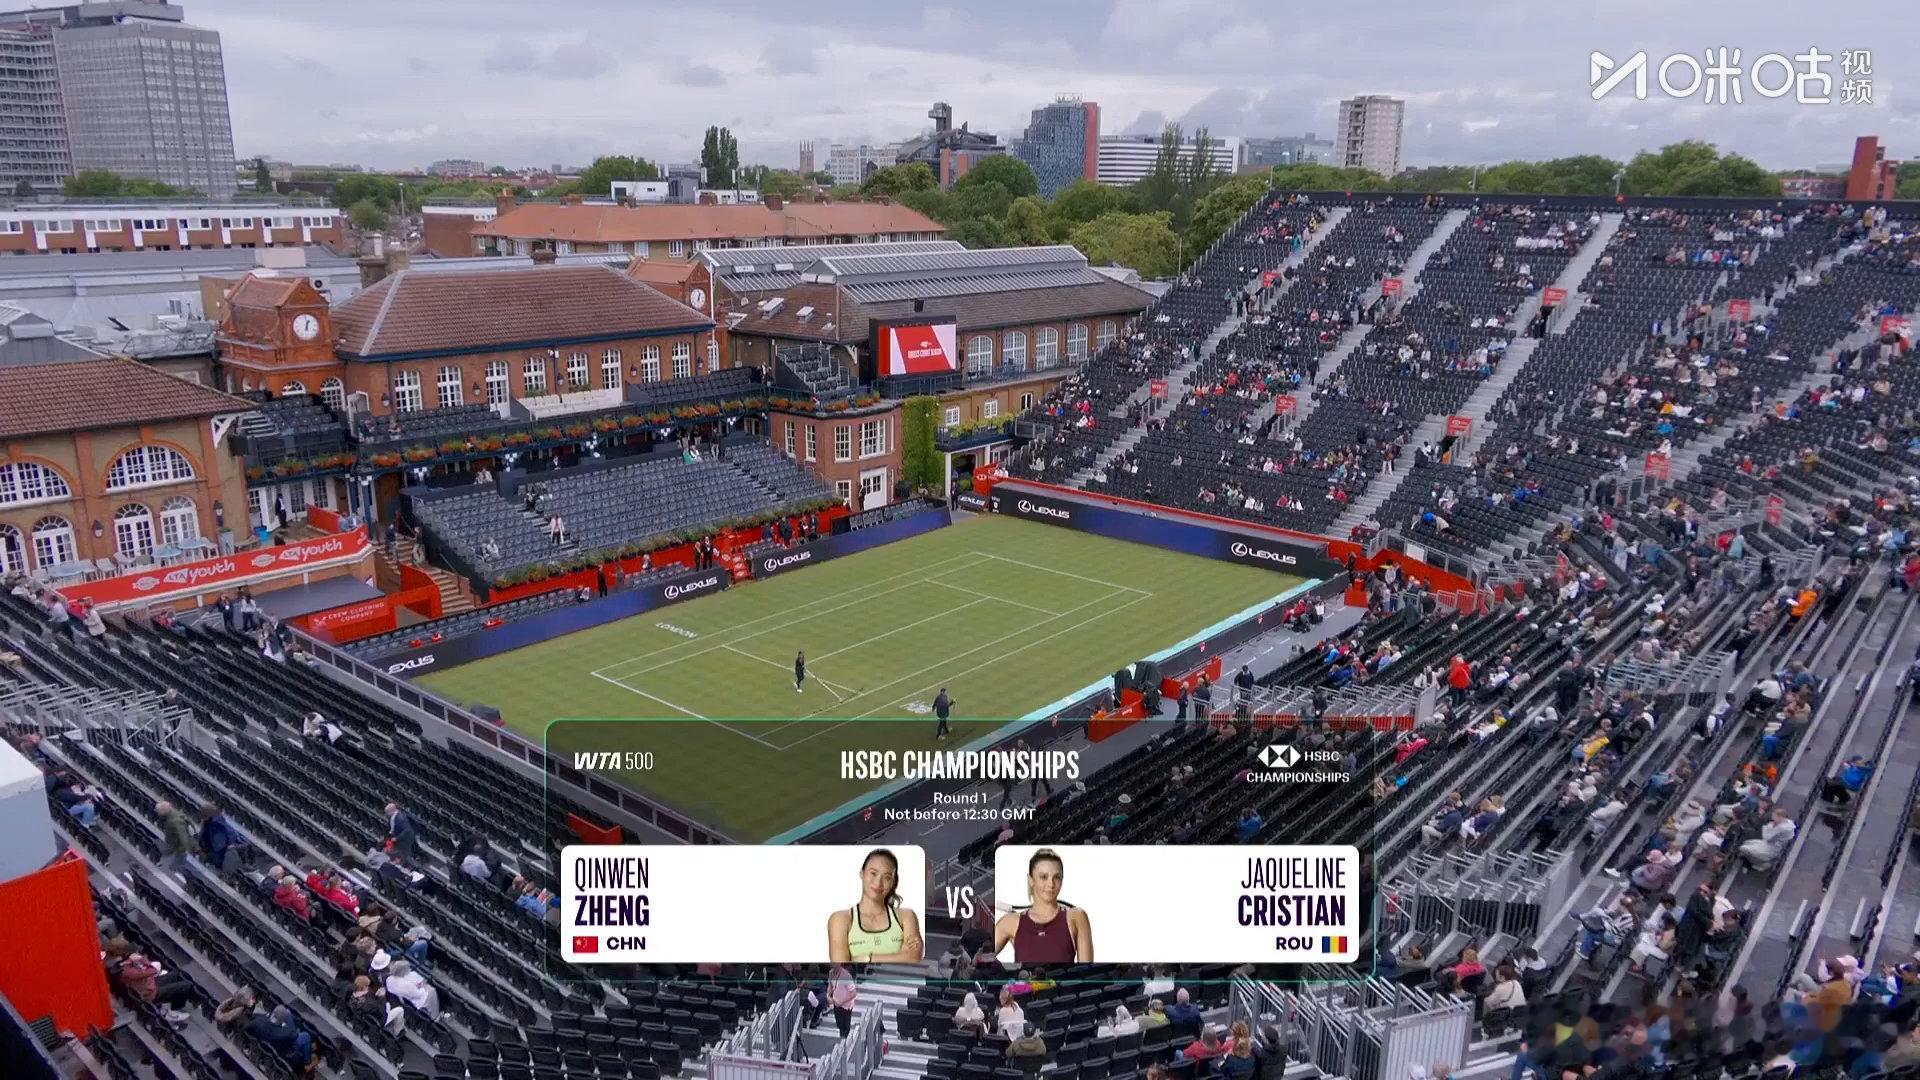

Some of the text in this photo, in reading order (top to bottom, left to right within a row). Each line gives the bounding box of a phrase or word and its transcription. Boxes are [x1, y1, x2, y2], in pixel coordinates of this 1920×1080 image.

[960, 496, 986, 506] EXUS
[1031, 504, 1070, 519] LEXUS
[301, 538, 343, 562] youth
[1248, 547, 1297, 565] LEXUS
[776, 551, 811, 567] LEXUS
[189, 560, 236, 584] youth
[678, 576, 718, 593] LEXUS
[328, 611, 348, 620] CREW
[340, 610, 375, 623] COMPANY
[655, 622, 698, 640] LONDON
